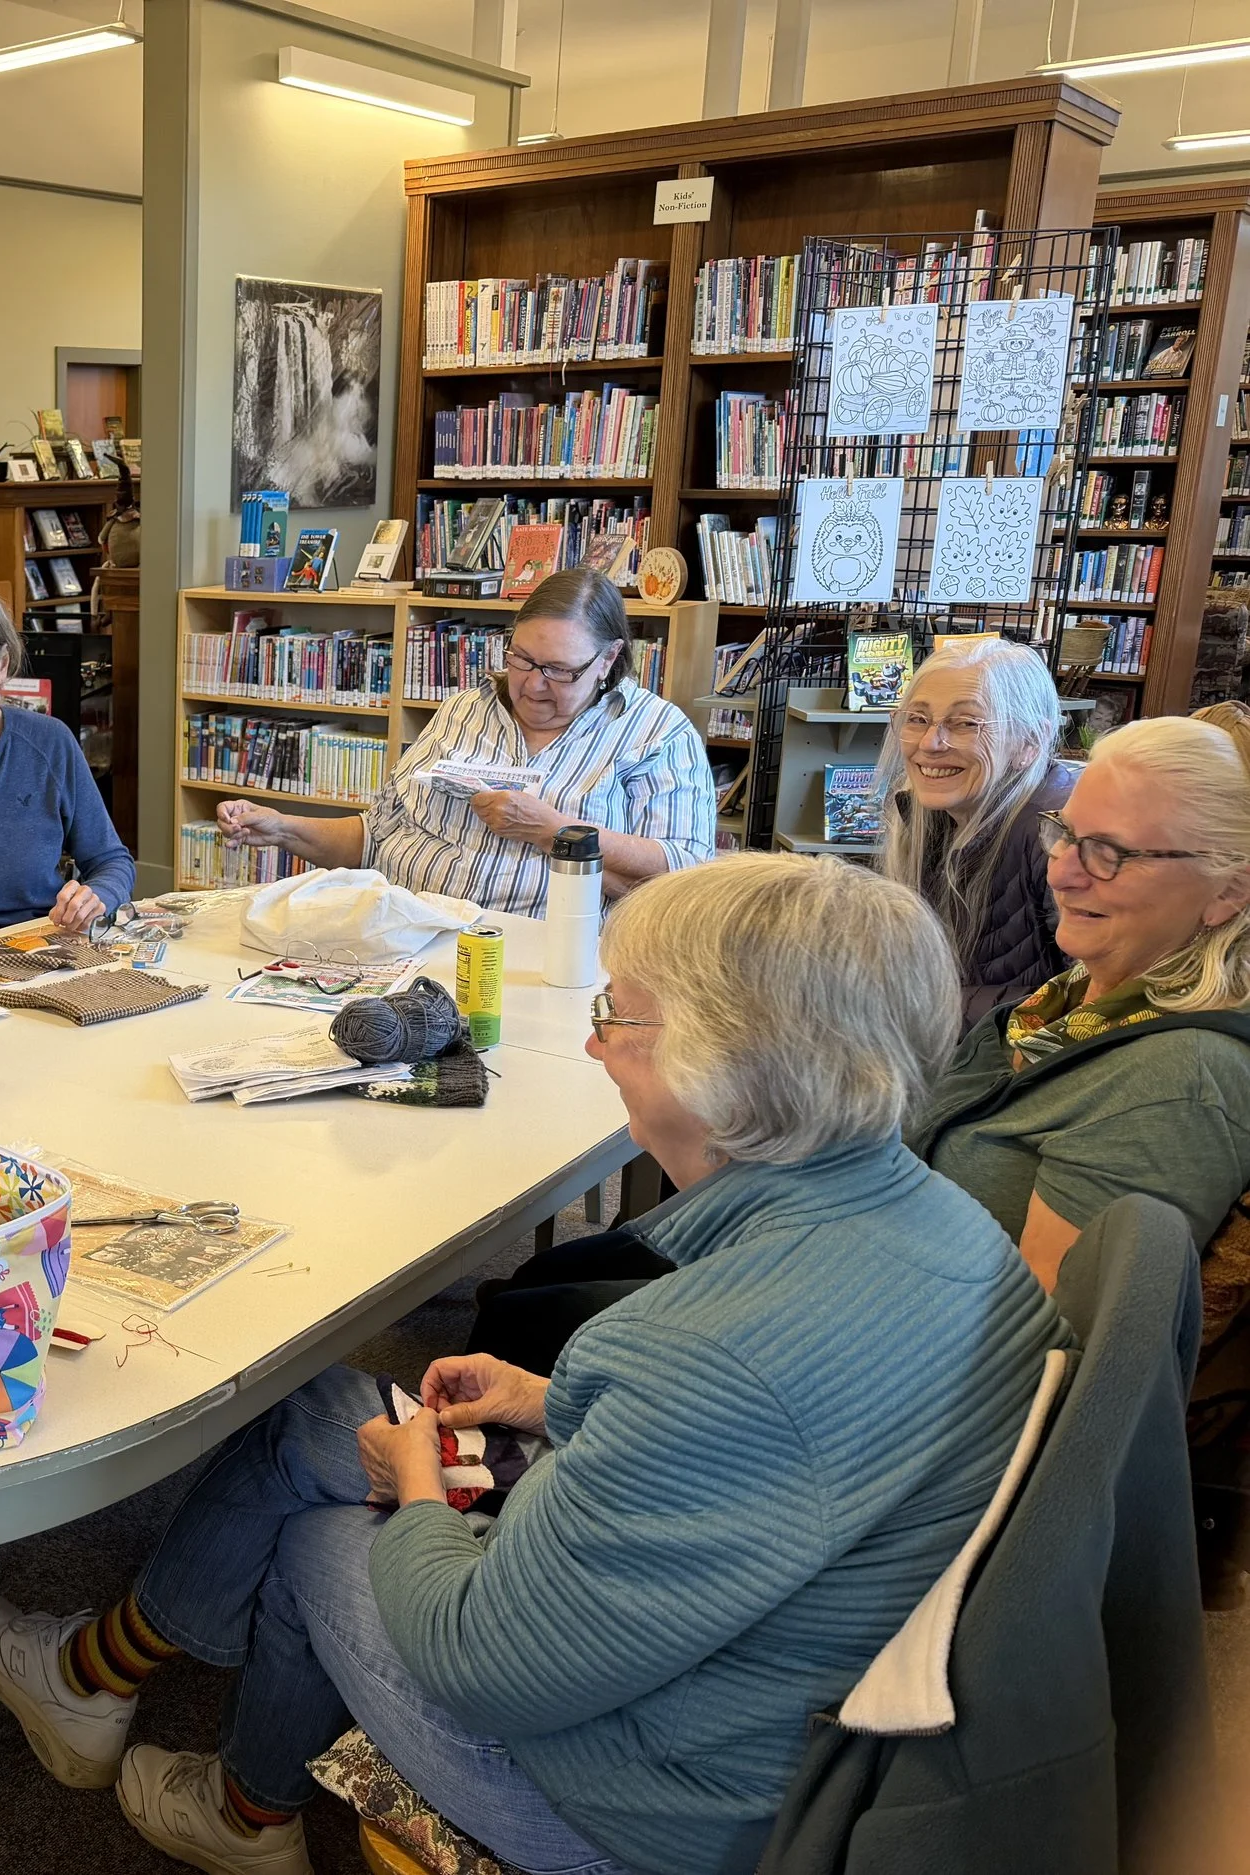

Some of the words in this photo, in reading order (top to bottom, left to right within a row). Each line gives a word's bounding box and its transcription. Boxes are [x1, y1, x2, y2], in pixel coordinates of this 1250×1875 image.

[673, 191, 695, 200] Kids'
[658, 201, 707, 212] Non-Fiction
[1159, 329, 1196, 338] CARROLL
[820, 485, 854, 501] Hell
[857, 482, 888, 500] Fall
[858, 636, 907, 652] MIGHTY
[856, 649, 904, 659] ROBOT
[833, 771, 872, 783] MIGHT
